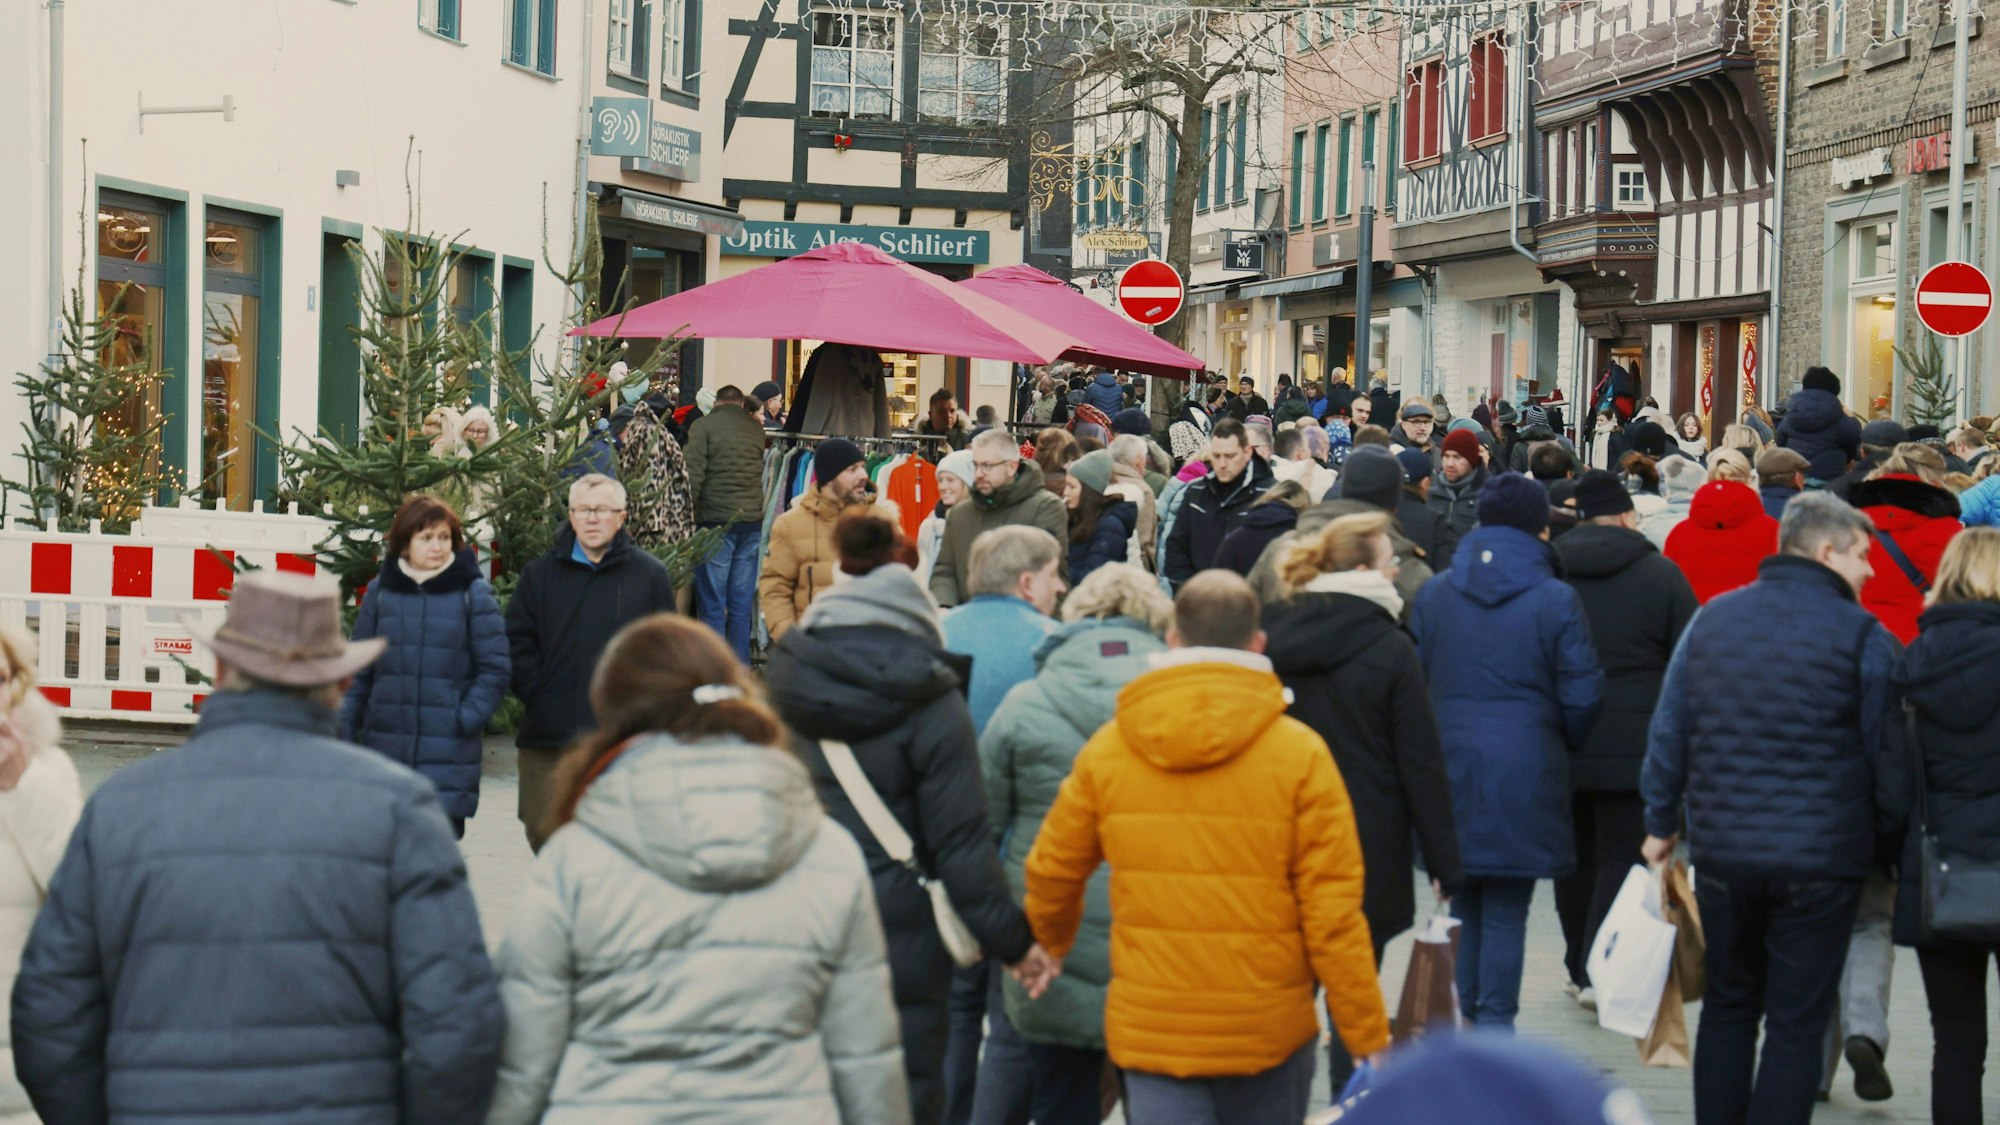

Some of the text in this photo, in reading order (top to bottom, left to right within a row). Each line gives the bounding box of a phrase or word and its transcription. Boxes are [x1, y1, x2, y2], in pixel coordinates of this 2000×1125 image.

[652, 123, 690, 148] HÖRAKUSTIK
[651, 143, 690, 167] SCHLIERF
[636, 201, 671, 223] HÖRAKUSTIK
[672, 210, 698, 227] SCHLIERF
[726, 228, 798, 252] Optik
[879, 231, 978, 257] Schlierf
[1087, 236, 1143, 248] Alex Schlierf
